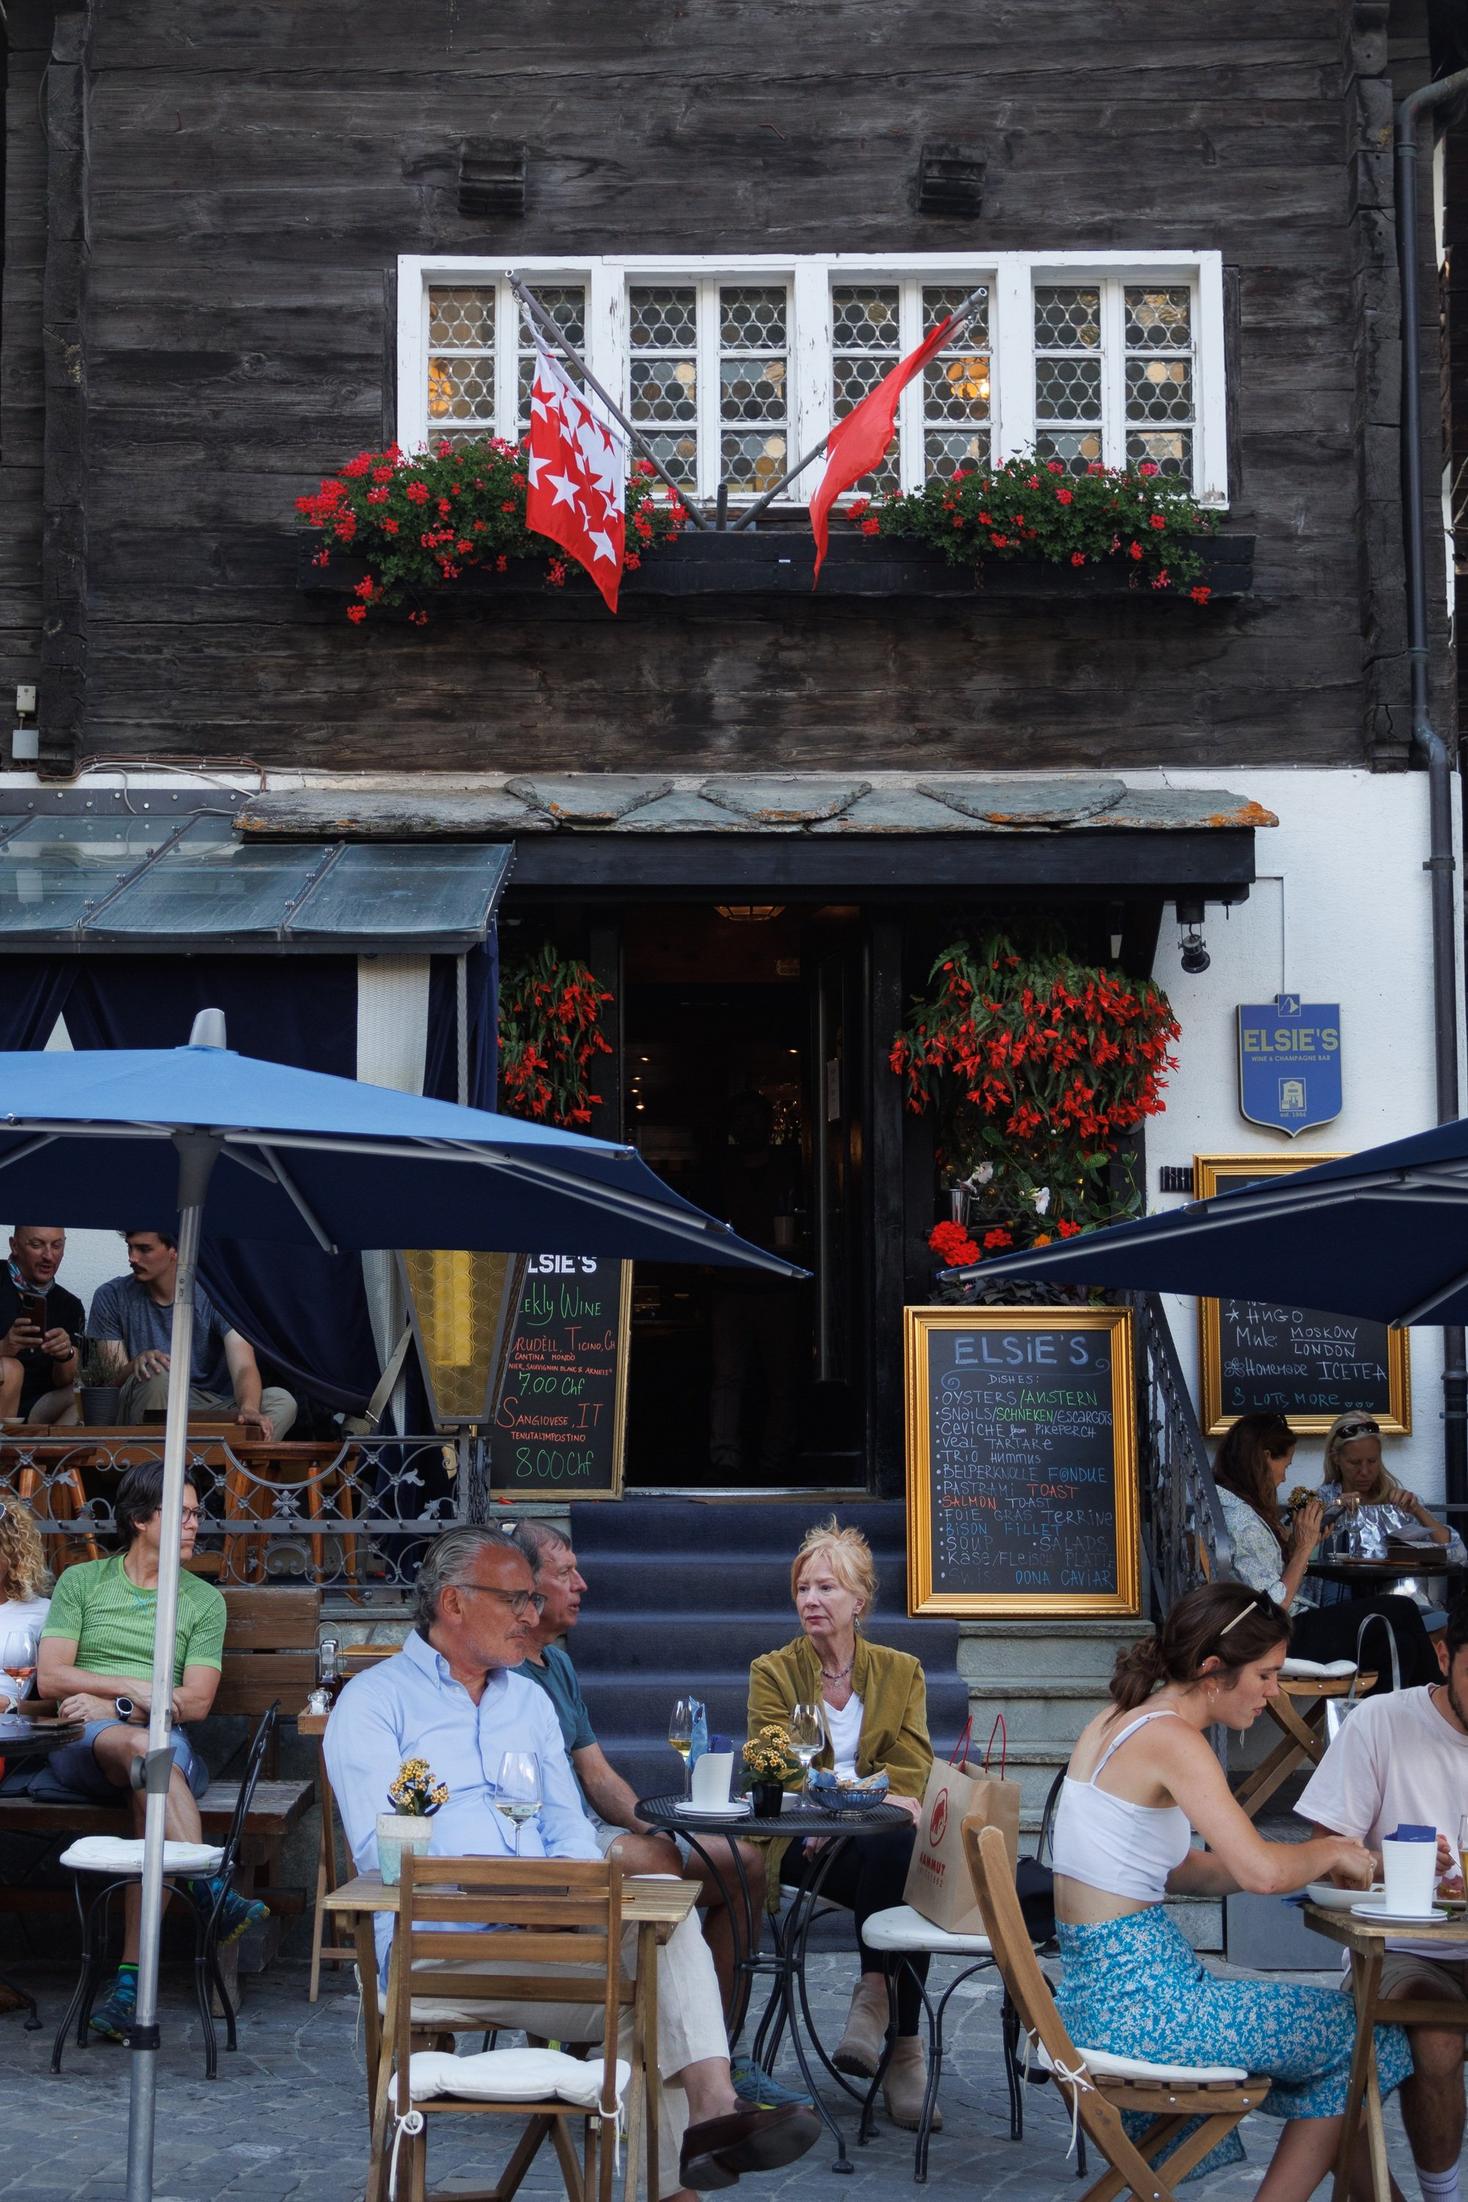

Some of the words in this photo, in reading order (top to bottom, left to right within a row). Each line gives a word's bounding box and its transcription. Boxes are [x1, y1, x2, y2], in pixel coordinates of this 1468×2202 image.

[1243, 1028, 1339, 1052] ELSIE'S
[528, 1253, 598, 1273] LSIE'S
[1290, 1326, 1358, 1341] MOSKOW
[514, 1353, 545, 1361] CANTINA
[1294, 1343, 1357, 1358] LONDON
[1315, 1361, 1388, 1382] ICETEA
[519, 1371, 557, 1396] 7.00
[1253, 1392, 1289, 1408] LOTS
[516, 1447, 565, 1480] 8.00
[1026, 1483, 1081, 1500] TOAST
[942, 1495, 997, 1510] SALMON
[1004, 1496, 1054, 1509] TOAST
[993, 1509, 1033, 1522] GRAS
[945, 1536, 994, 1551] SOUP
[1039, 1535, 1110, 1551] SALADS
